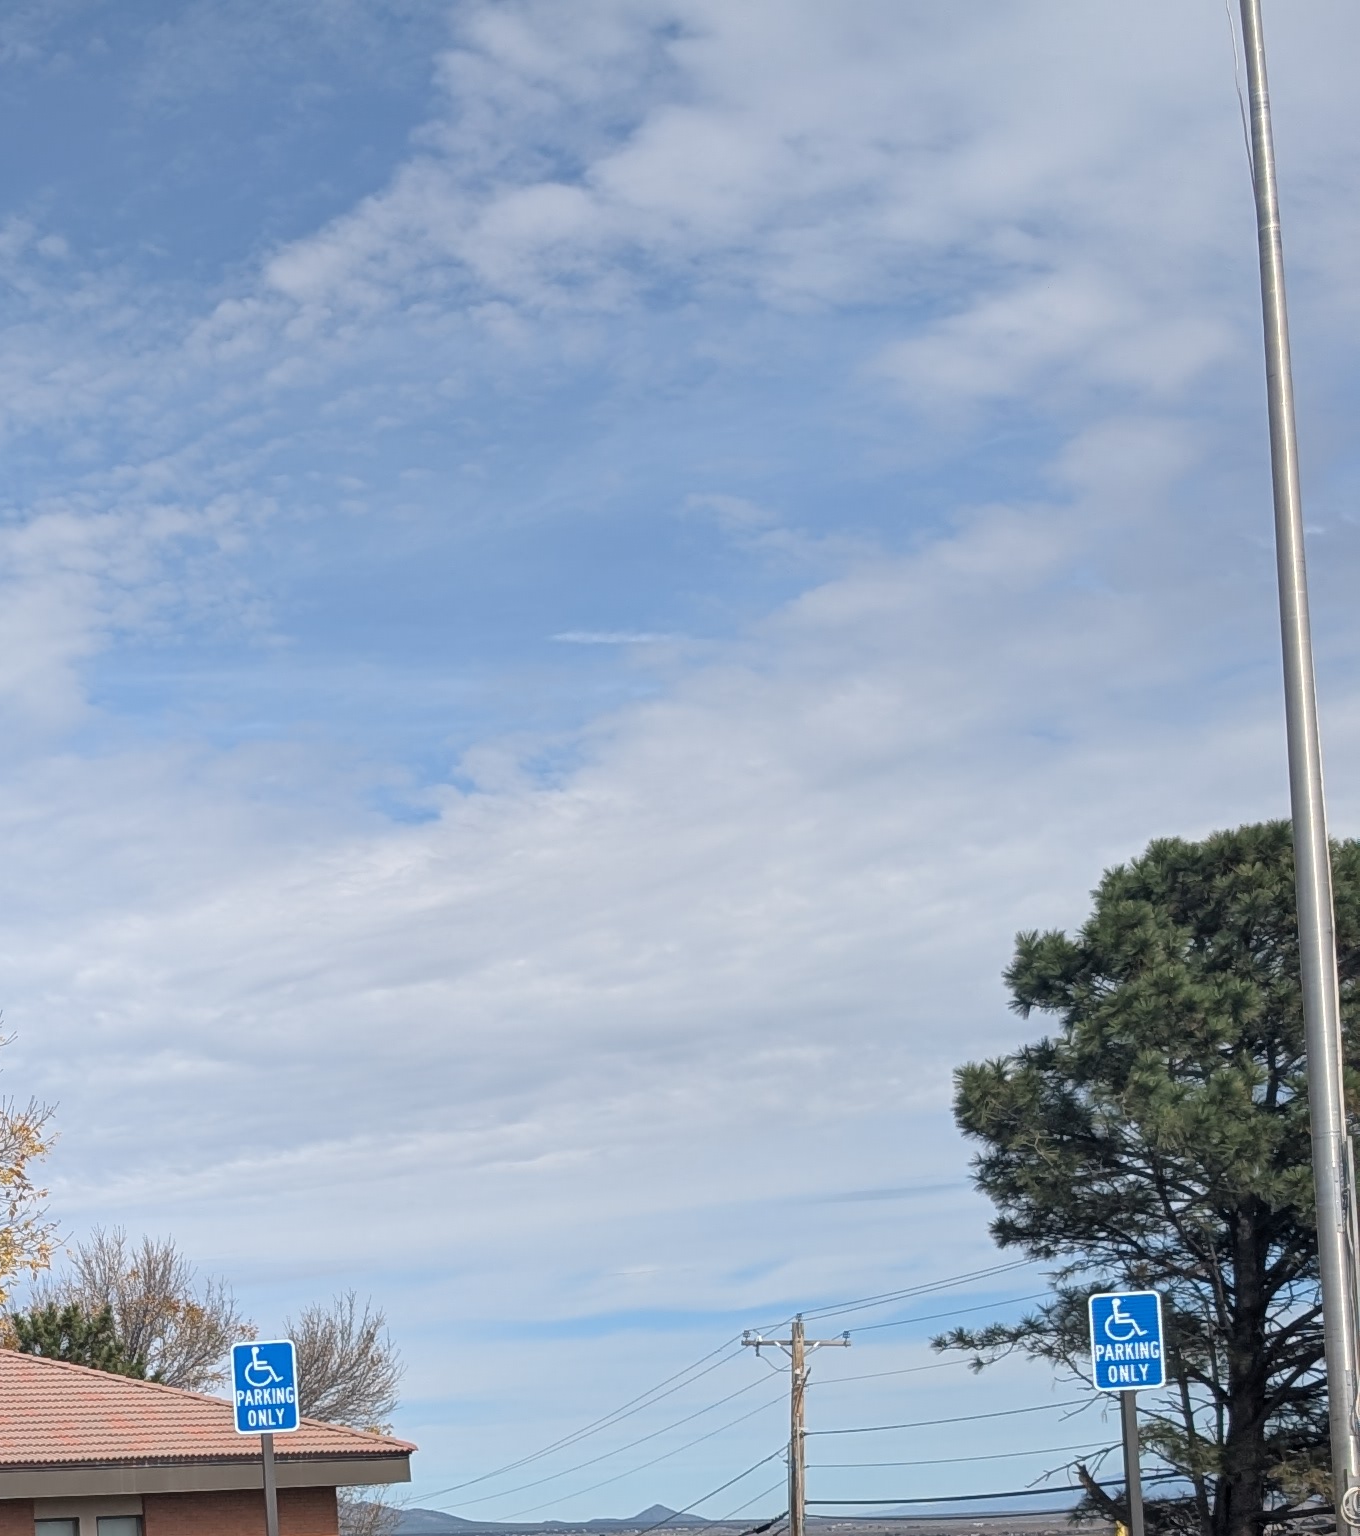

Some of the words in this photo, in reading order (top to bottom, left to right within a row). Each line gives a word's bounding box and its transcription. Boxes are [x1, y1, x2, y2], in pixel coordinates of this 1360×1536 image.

[1095, 1340, 1160, 1361] PARKING
[1107, 1363, 1149, 1383] ONLY
[237, 1386, 294, 1406] PARKING
[247, 1408, 286, 1427] ONLY
